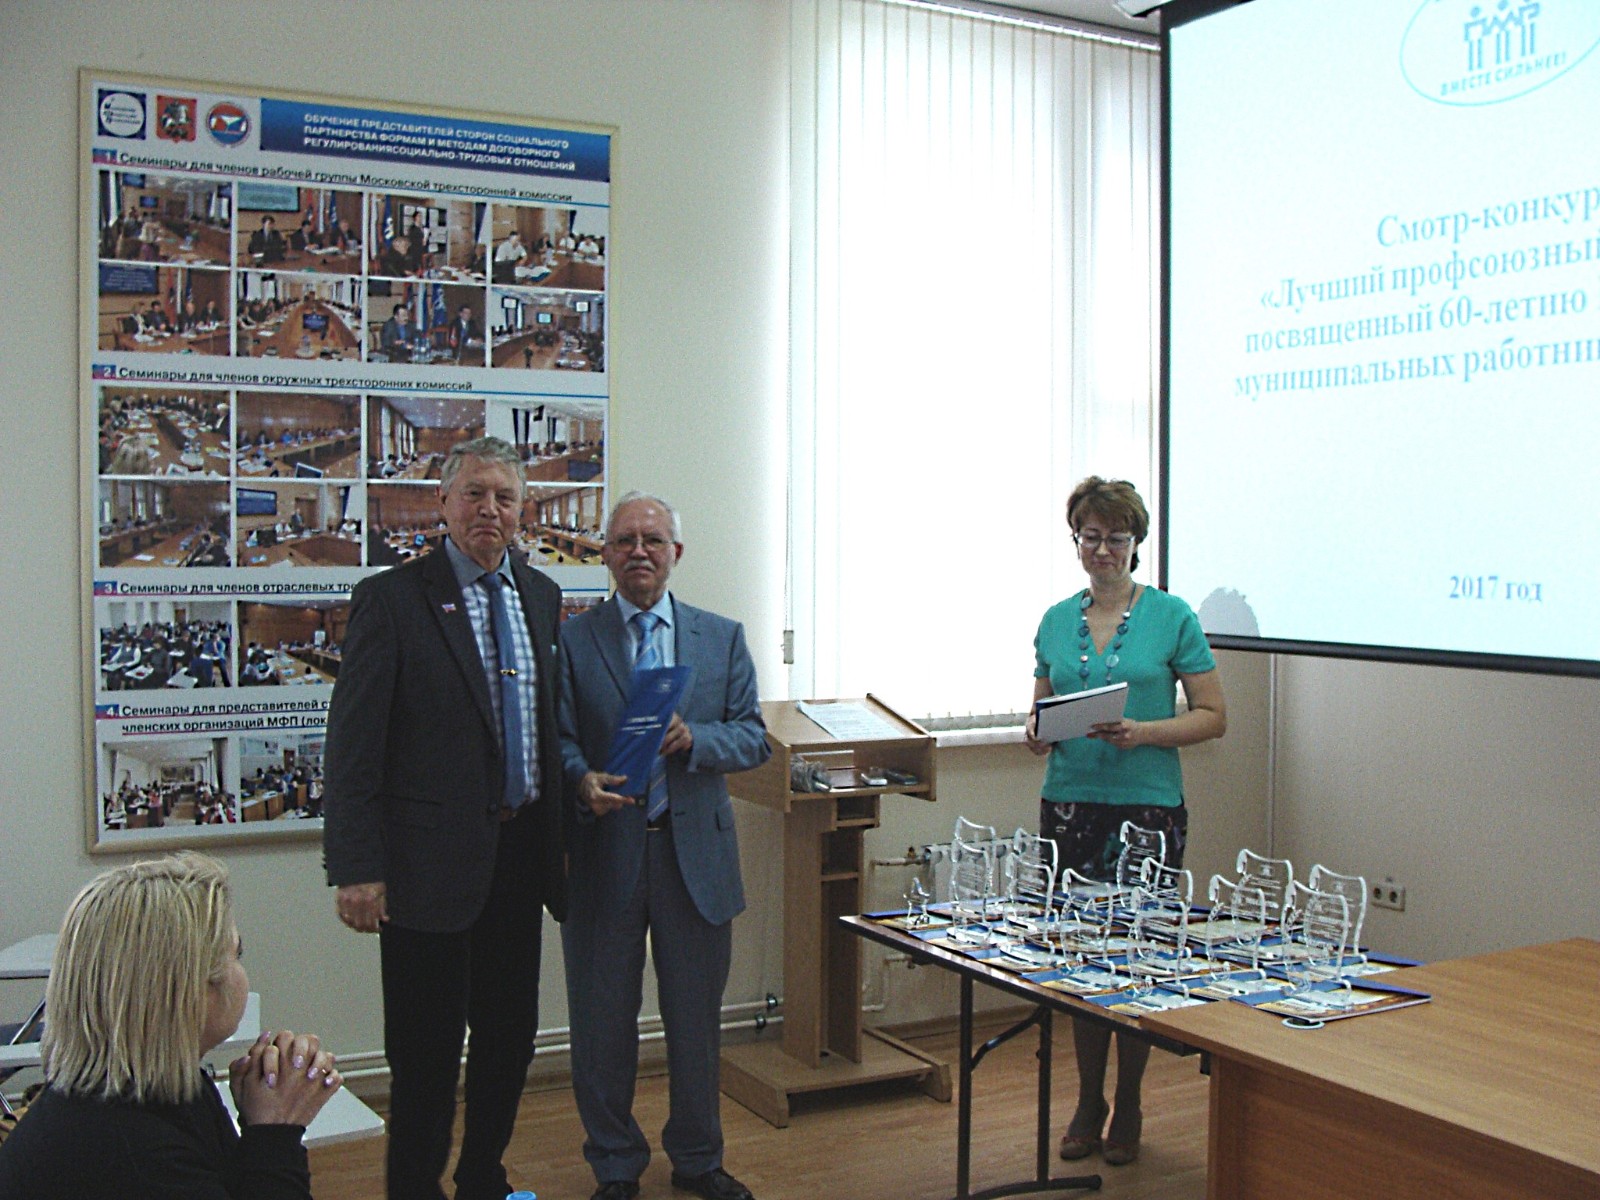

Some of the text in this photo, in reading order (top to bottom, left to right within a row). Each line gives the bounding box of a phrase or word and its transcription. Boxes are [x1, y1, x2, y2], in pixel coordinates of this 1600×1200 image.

[303, 113, 569, 149] ОБУЧЕНИЕ ПРЕДСТАВИТЕЛЕЙ СТОРОН СОЦИАЛЬНОГО
[303, 126, 560, 159] ПАРТНЕРСТВА ФОРМАМ И МЕТОДАМ ДОГОВОРНОГО
[119, 152, 188, 170] Семинары
[190, 160, 214, 171] для
[215, 164, 258, 175] членов
[261, 166, 312, 181] рабочей
[314, 172, 358, 186] группы
[360, 174, 431, 191] Московской
[433, 181, 516, 198] трехсторонней
[518, 190, 573, 203] комиссии
[514, 159, 576, 172] ОТНОШЕНИЙ
[1260, 265, 1385, 314] «Лучший
[1245, 288, 1588, 354] посвященный 60-летию
[119, 367, 187, 383] Семинары
[190, 373, 213, 382] для
[215, 373, 259, 383] членов
[262, 375, 322, 386] окружных
[325, 378, 413, 388] трехсторонних
[416, 380, 473, 391] комиссий
[1234, 353, 1456, 402] муниципальных
[120, 582, 189, 596] Семинары
[191, 583, 215, 594] для
[216, 584, 260, 593] членов
[262, 583, 334, 594] отраслевых
[1449, 575, 1543, 602] 2017 год
[122, 703, 190, 718] Семинары
[193, 703, 216, 714] для
[219, 699, 319, 716] представителей
[122, 719, 181, 732] членских
[183, 716, 265, 732] организаций
[267, 716, 299, 727] МФП
